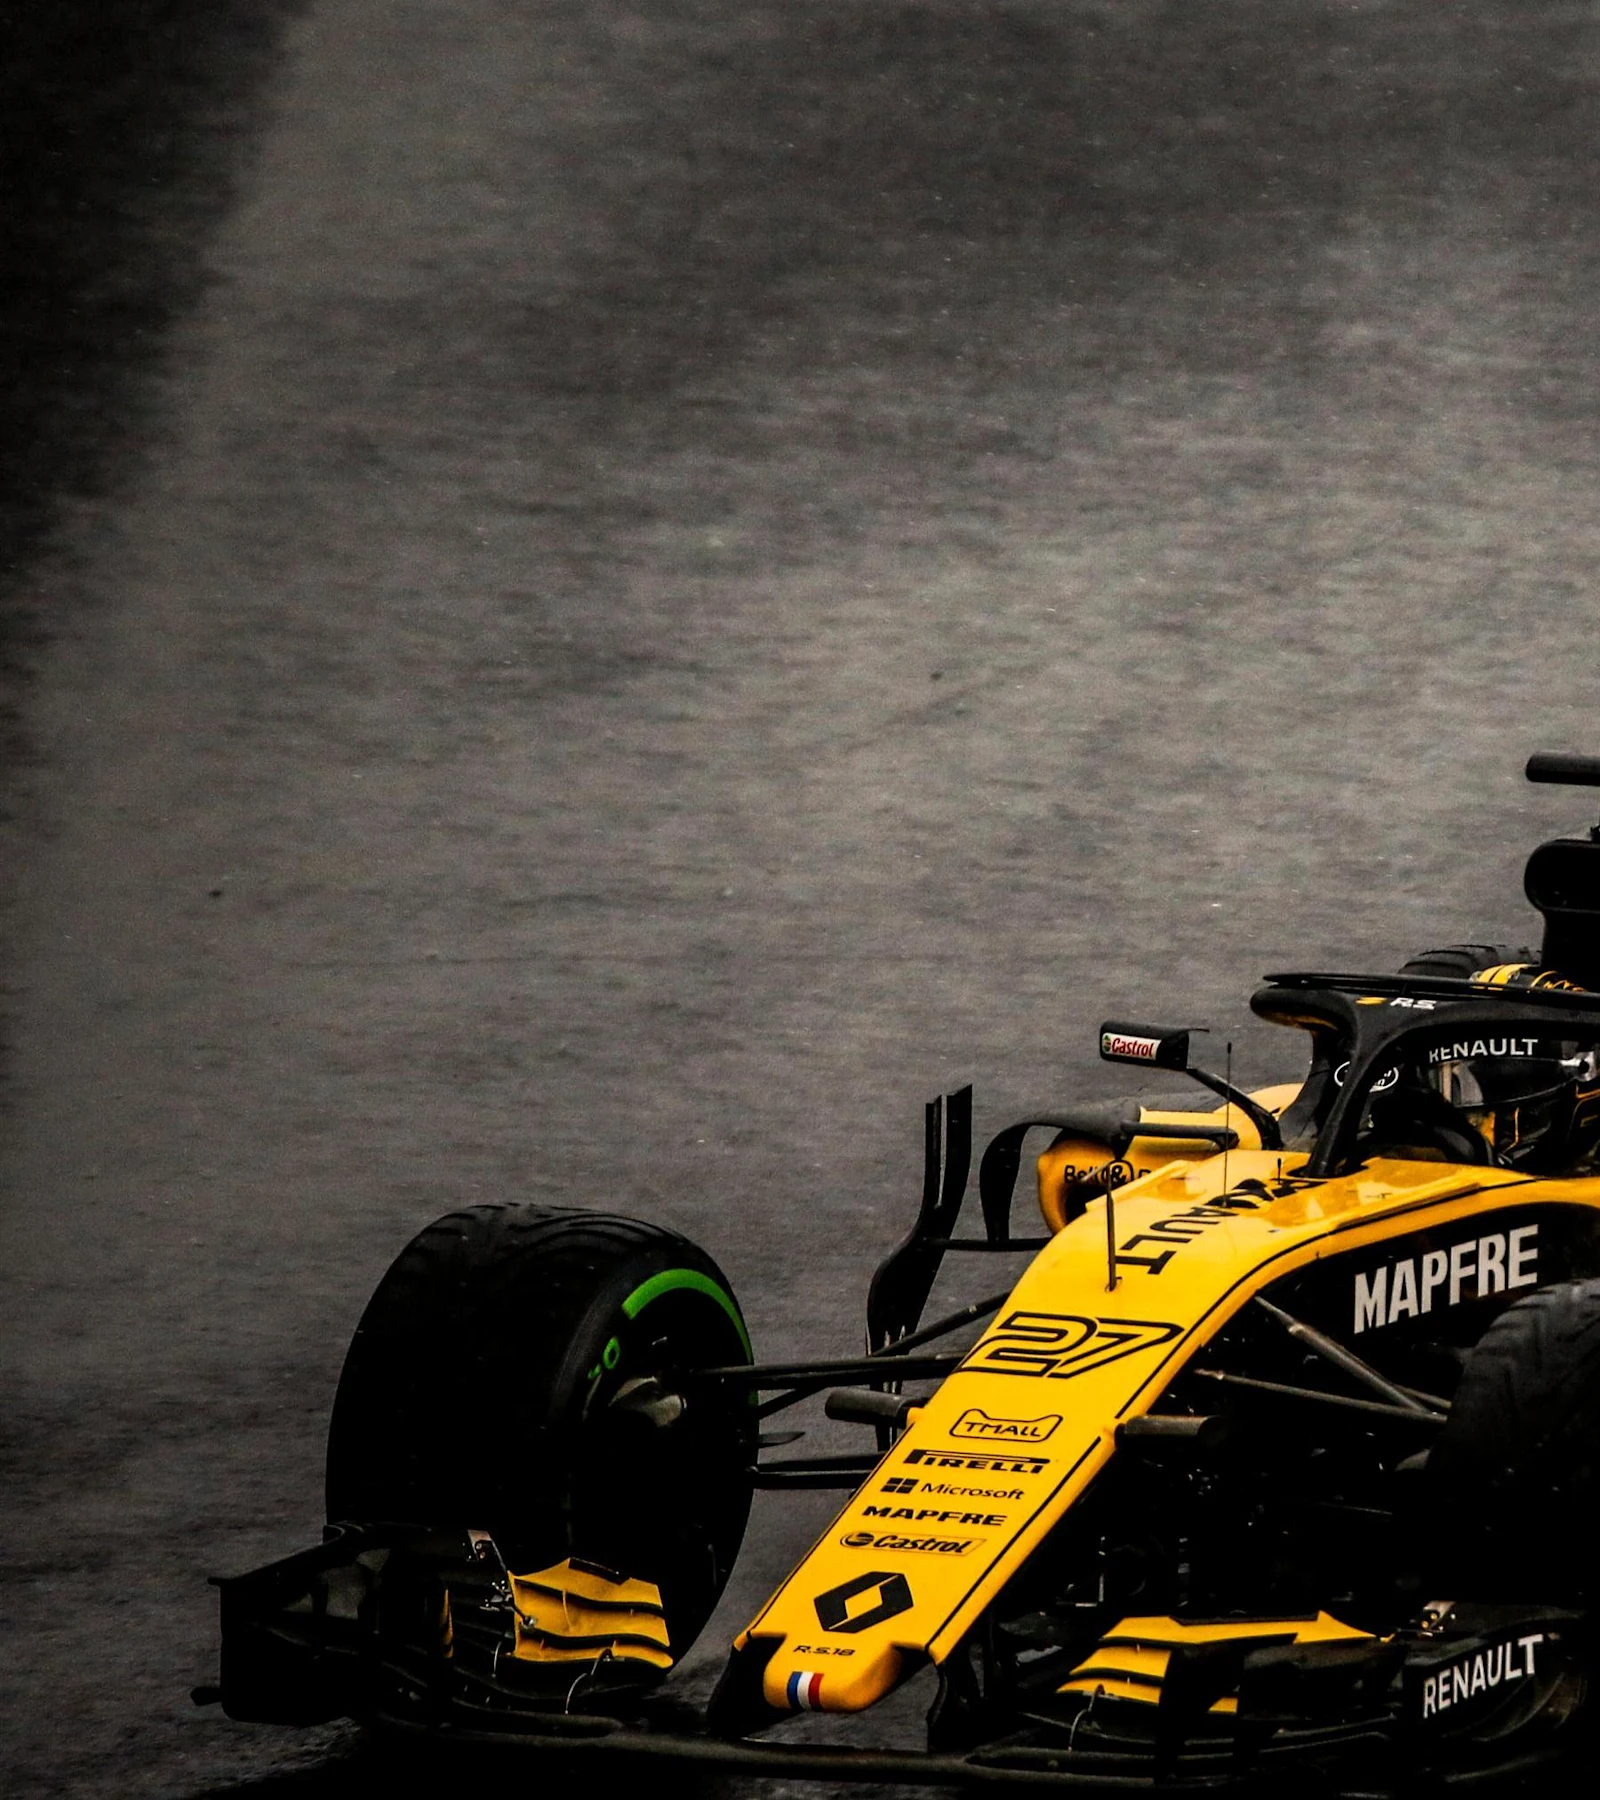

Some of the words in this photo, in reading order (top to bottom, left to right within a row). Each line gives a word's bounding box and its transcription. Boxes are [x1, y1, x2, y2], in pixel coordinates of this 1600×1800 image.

[1111, 1037, 1155, 1058] Castrol
[1353, 1223, 1539, 1334] MAPFRE
[950, 1311, 1184, 1379] 27
[963, 1421, 1042, 1437] TMALL
[903, 1448, 1051, 1475] PIRELLI
[921, 1482, 1026, 1500] Microsoft
[862, 1505, 1008, 1526] MAPFRE
[873, 1534, 972, 1553] Castrol
[793, 1644, 857, 1657] R.S.18
[1423, 1633, 1546, 1719] RENAULT
